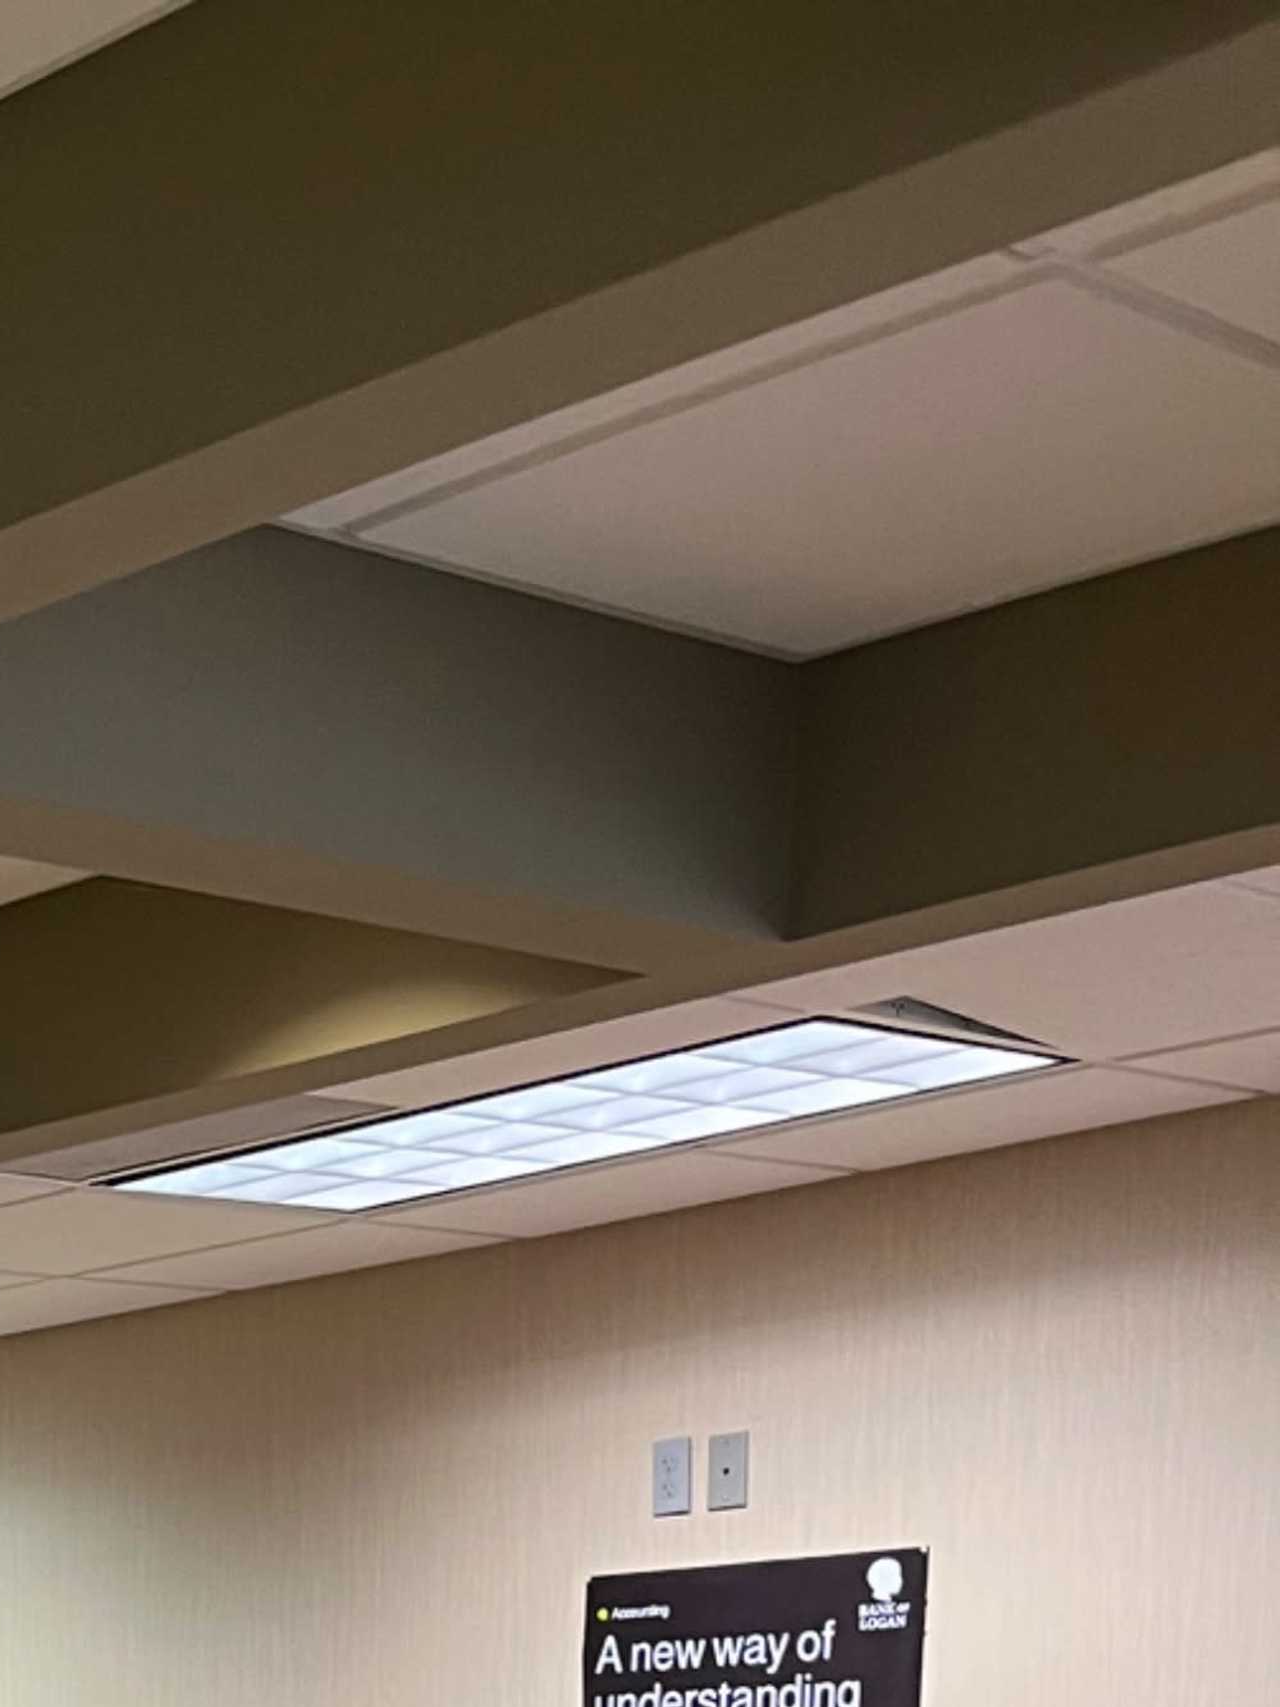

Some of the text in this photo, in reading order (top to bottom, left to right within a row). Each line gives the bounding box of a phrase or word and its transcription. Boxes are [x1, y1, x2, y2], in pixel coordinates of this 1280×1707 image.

[858, 1615, 907, 1631] LOGAN
[594, 1619, 836, 1675] A new way of
